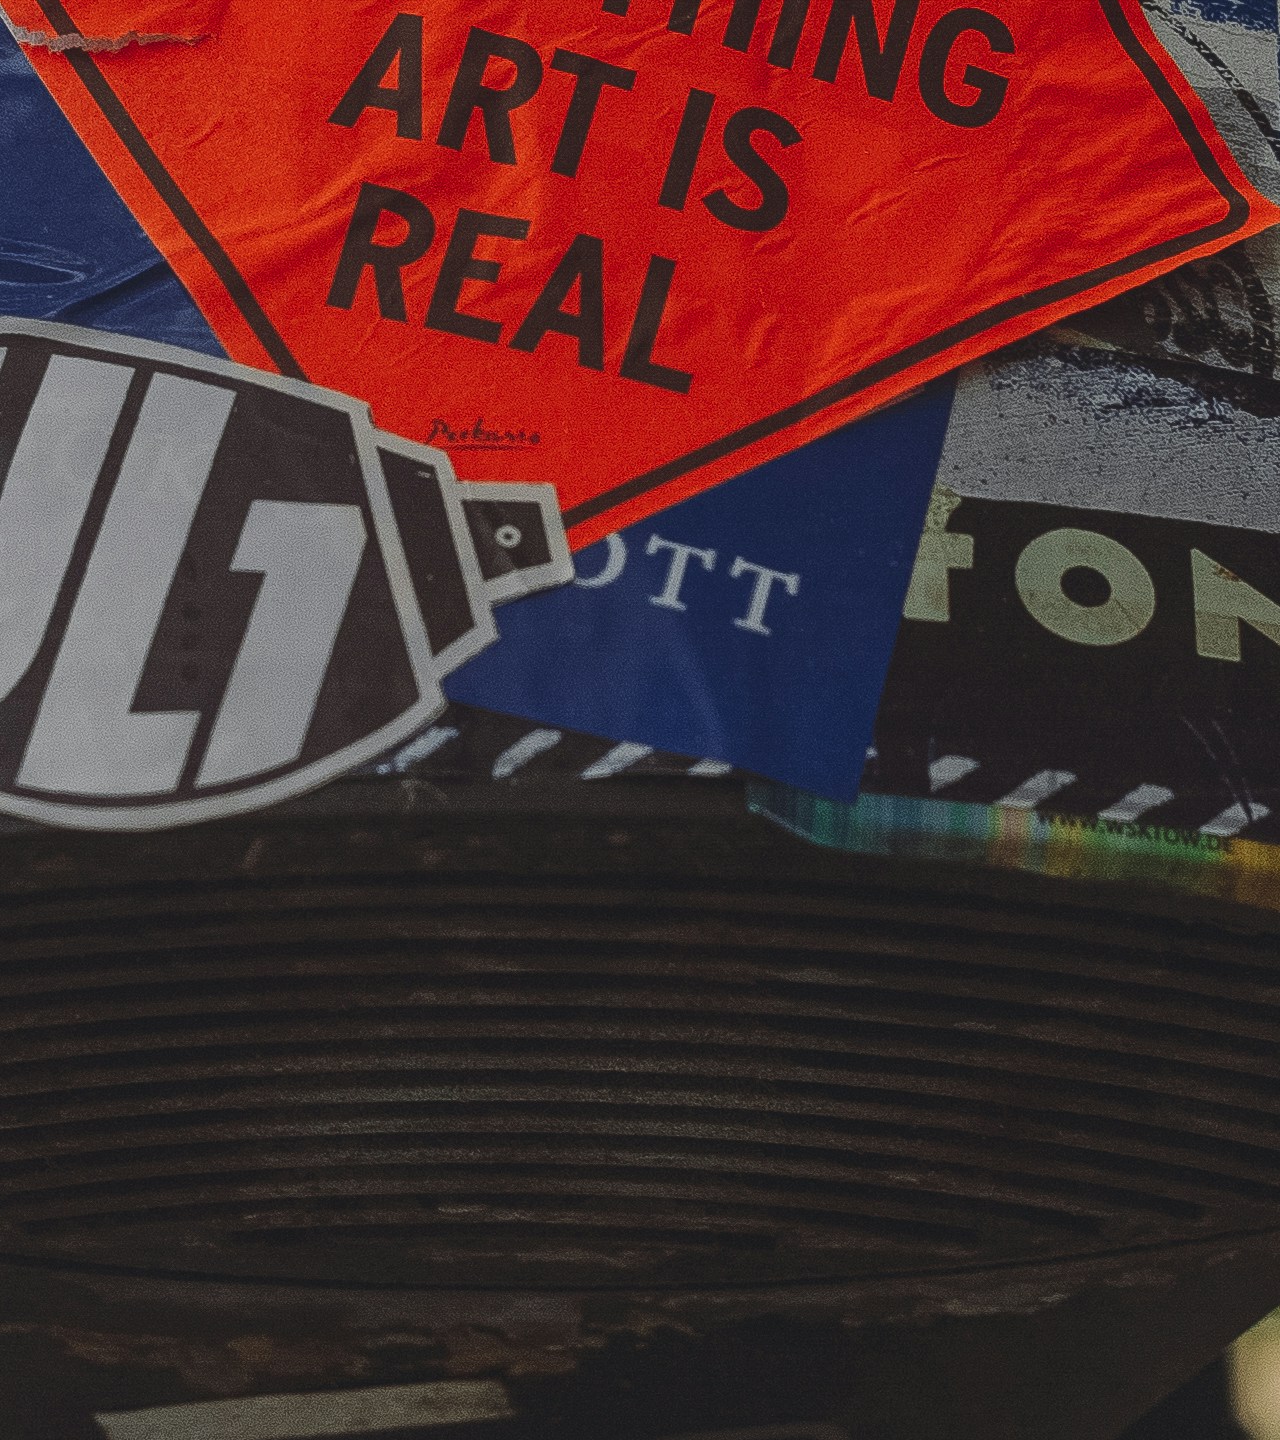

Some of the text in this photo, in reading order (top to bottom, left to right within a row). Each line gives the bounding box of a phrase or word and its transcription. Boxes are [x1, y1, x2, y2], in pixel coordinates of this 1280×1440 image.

[328, 12, 804, 233] ART IS
[326, 180, 695, 395] REAL
